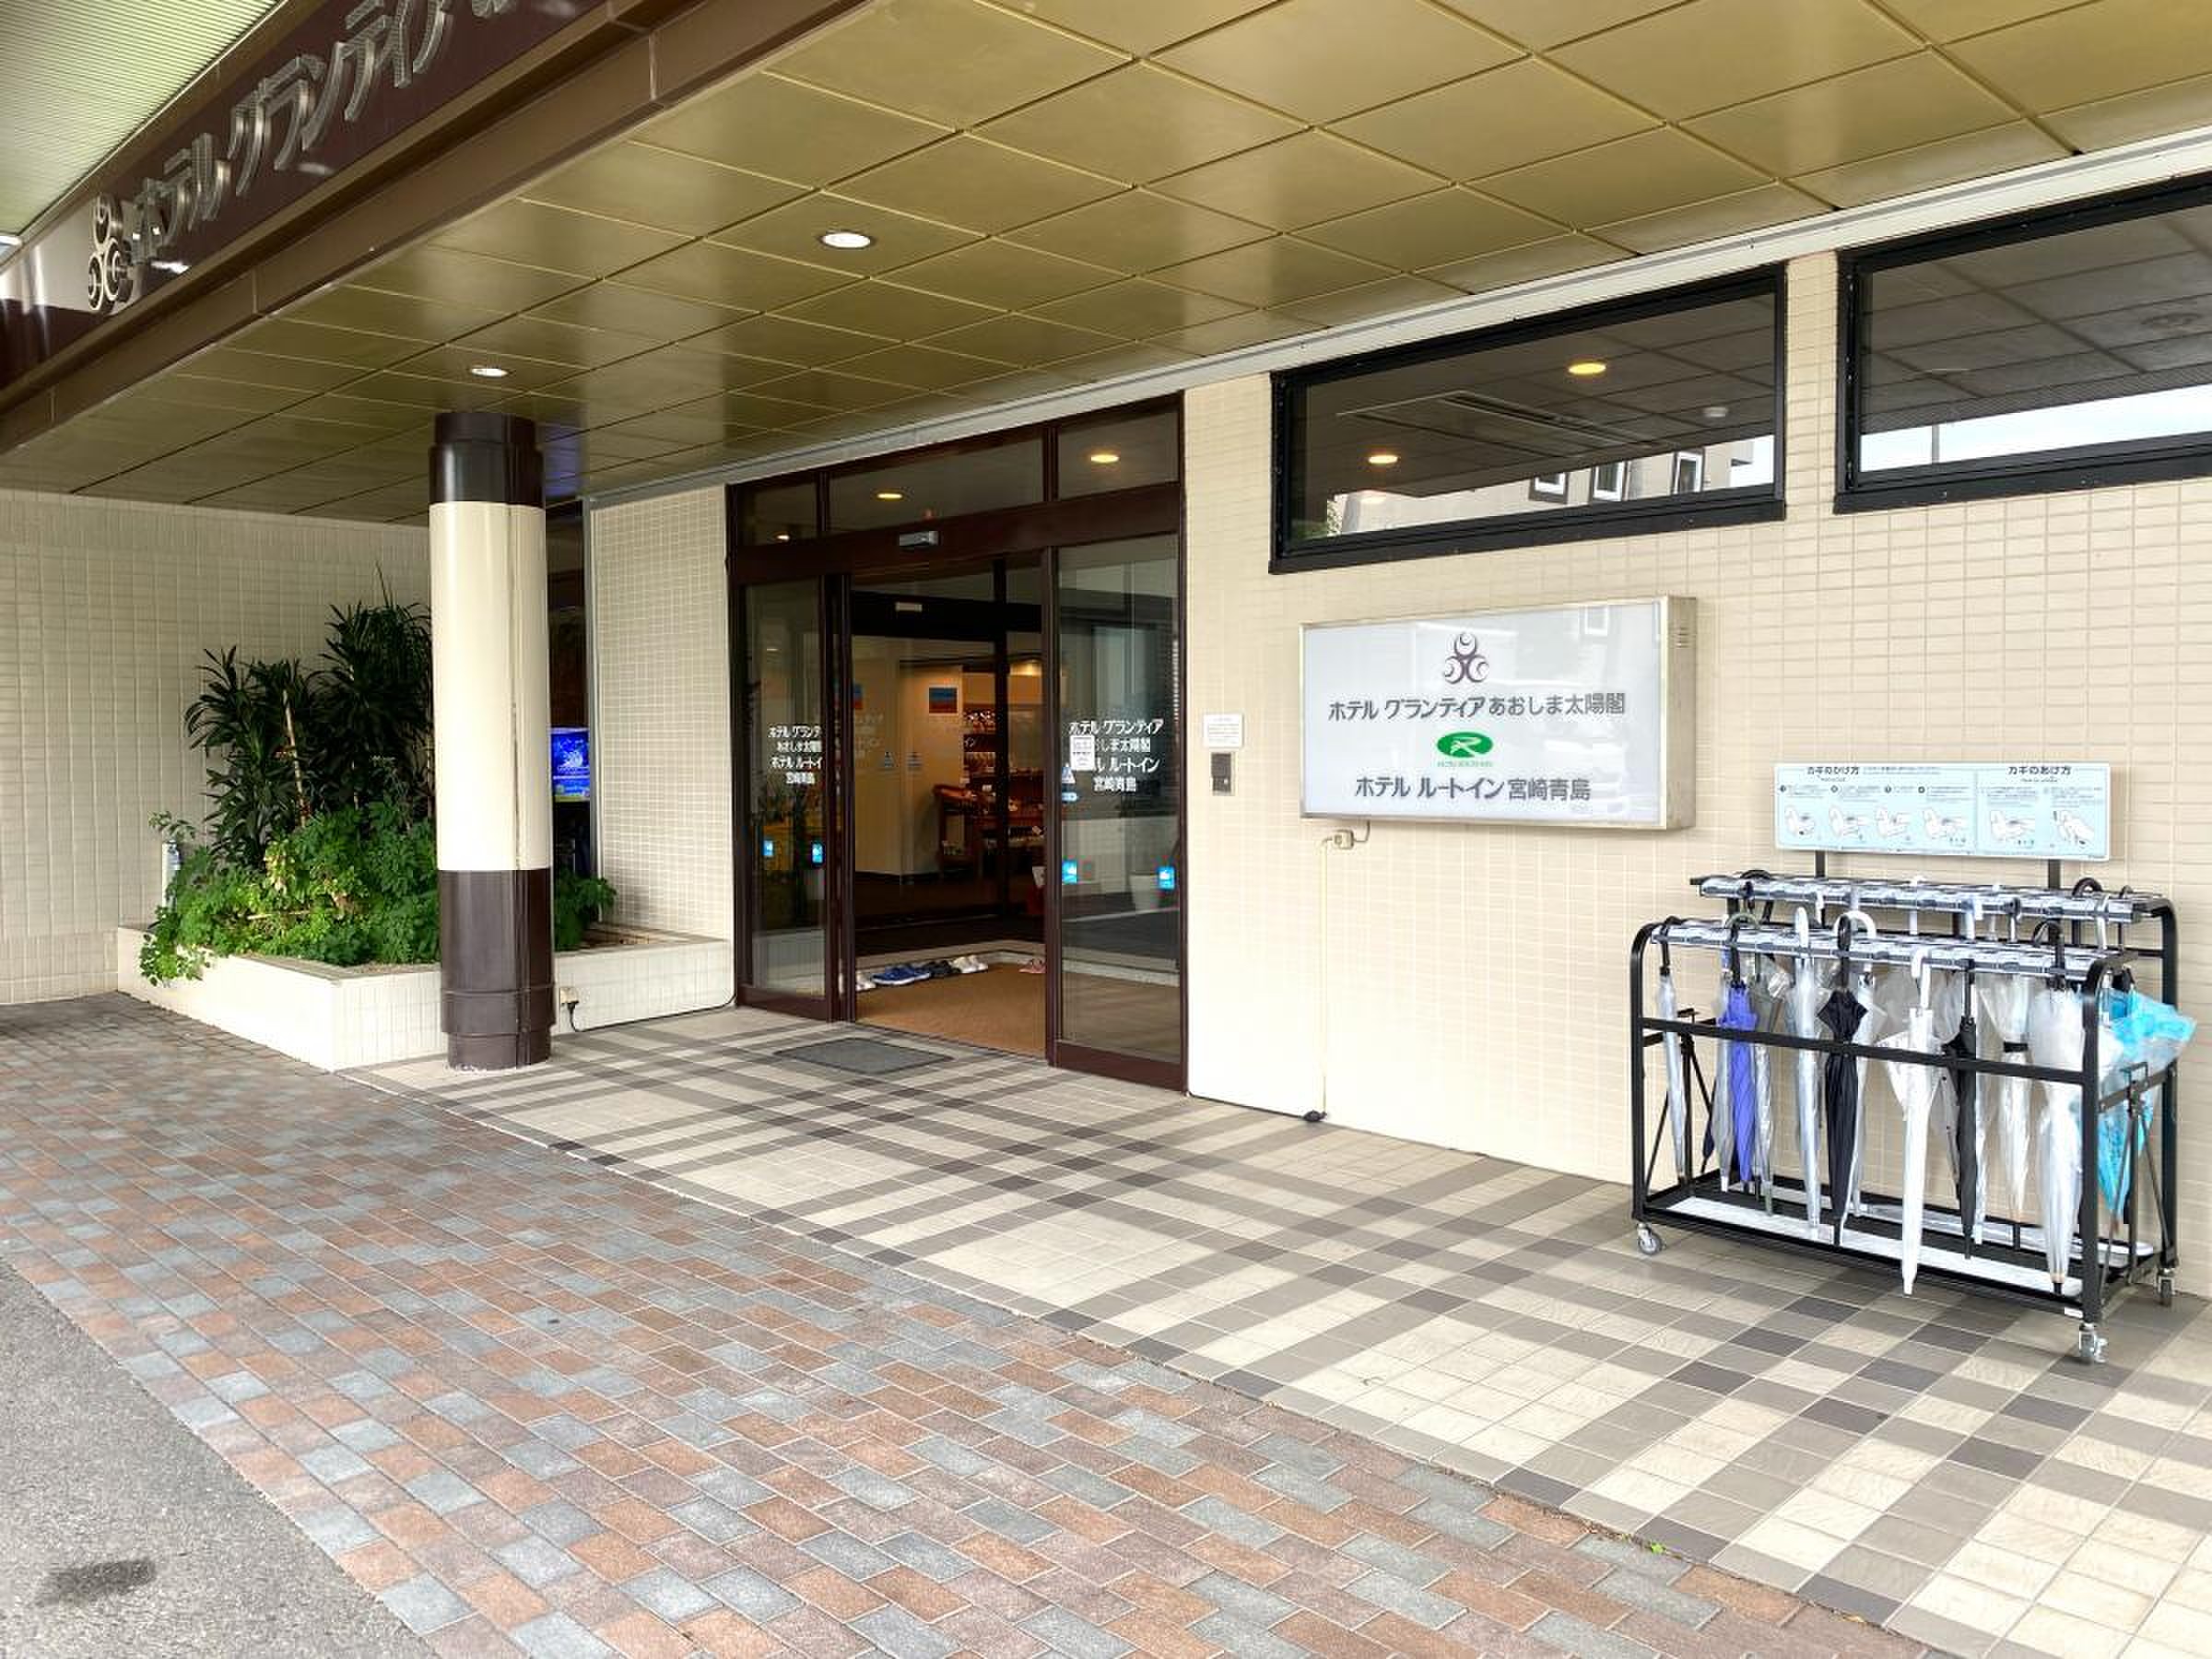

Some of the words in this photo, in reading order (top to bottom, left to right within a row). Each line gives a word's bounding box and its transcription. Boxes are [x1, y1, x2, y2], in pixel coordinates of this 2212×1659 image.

[1328, 700, 1380, 721] ホテル
[1068, 720, 1101, 735] ホテル
[1095, 737, 1151, 753] しま太陽閣
[1355, 777, 1411, 797] ホテル
